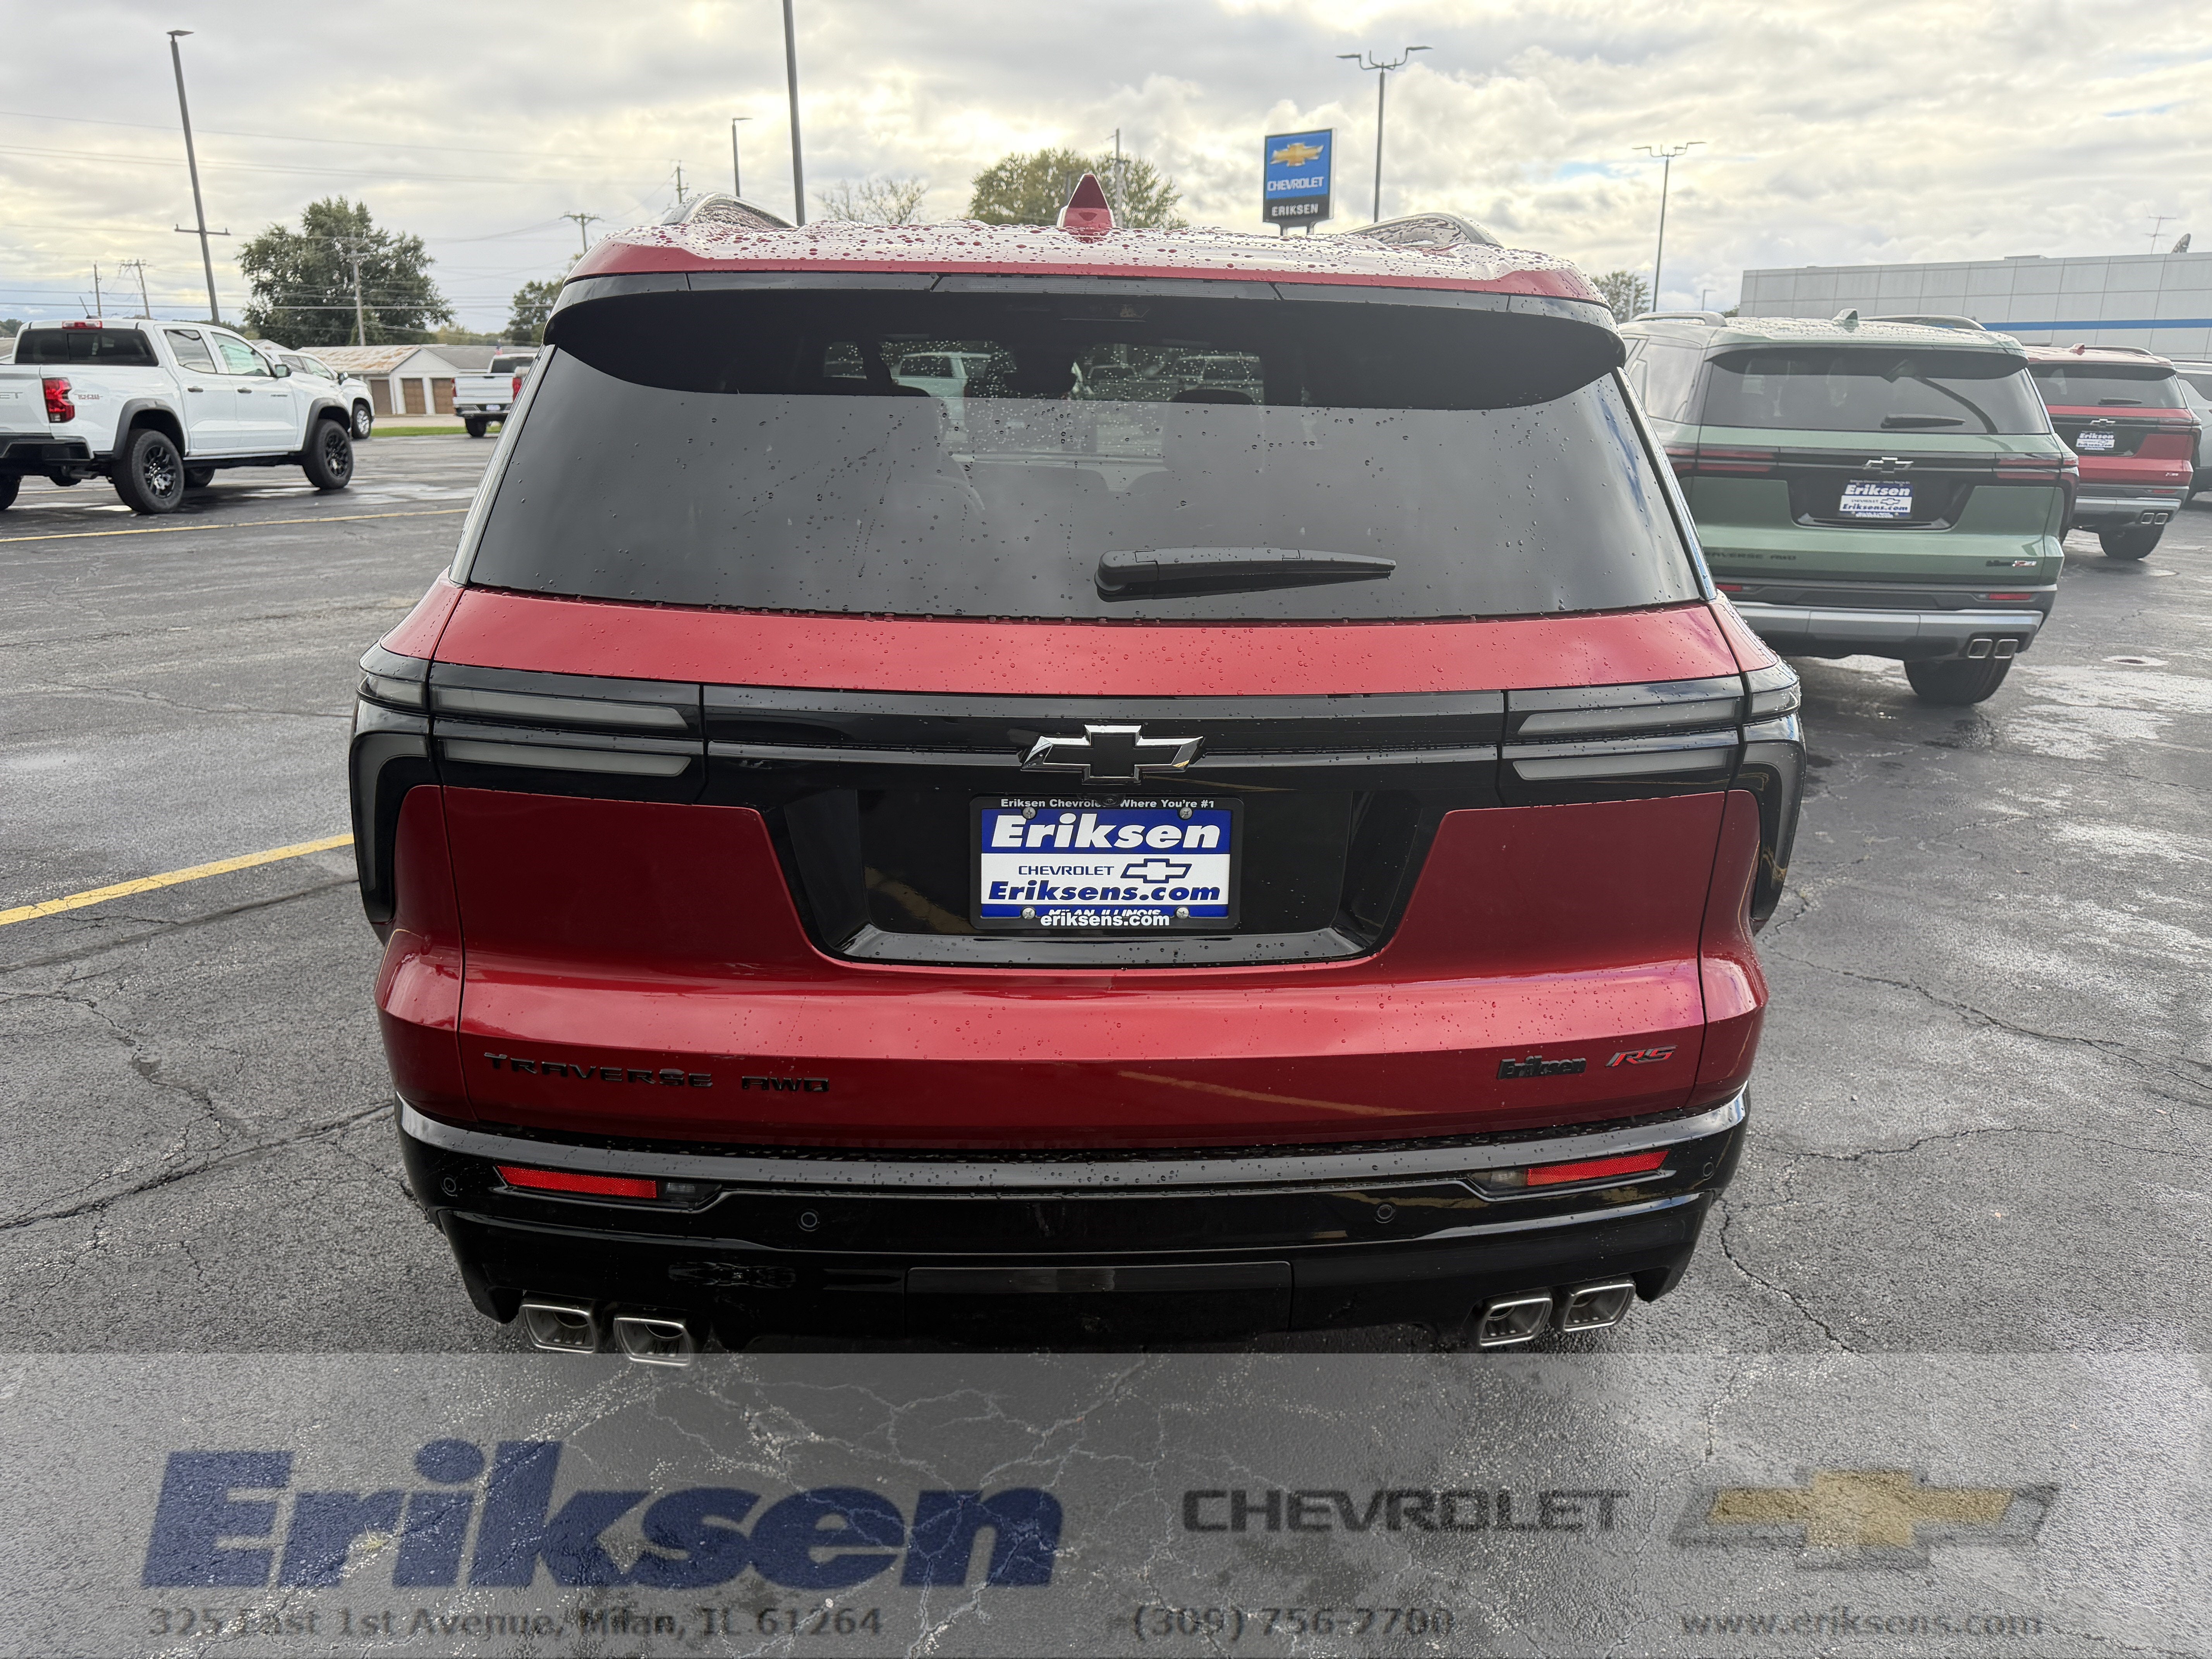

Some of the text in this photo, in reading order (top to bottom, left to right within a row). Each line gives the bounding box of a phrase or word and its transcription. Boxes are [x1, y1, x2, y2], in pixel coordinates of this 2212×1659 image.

[1267, 177, 1324, 192] CHEVROLET
[1271, 203, 1318, 216] ERIKSEN
[1001, 799, 1046, 807] Eriksen
[1161, 799, 1197, 808] You're
[1201, 799, 1214, 808] #1
[991, 813, 1220, 848] Eriksen
[1018, 866, 1115, 876] CHEVROLET
[988, 880, 1220, 901] Eriksens.com
[1040, 912, 1170, 926] eriksens.com
[1497, 1045, 1678, 1079] Eriksen RS
[483, 1052, 830, 1092] TRAVERSE AWD
